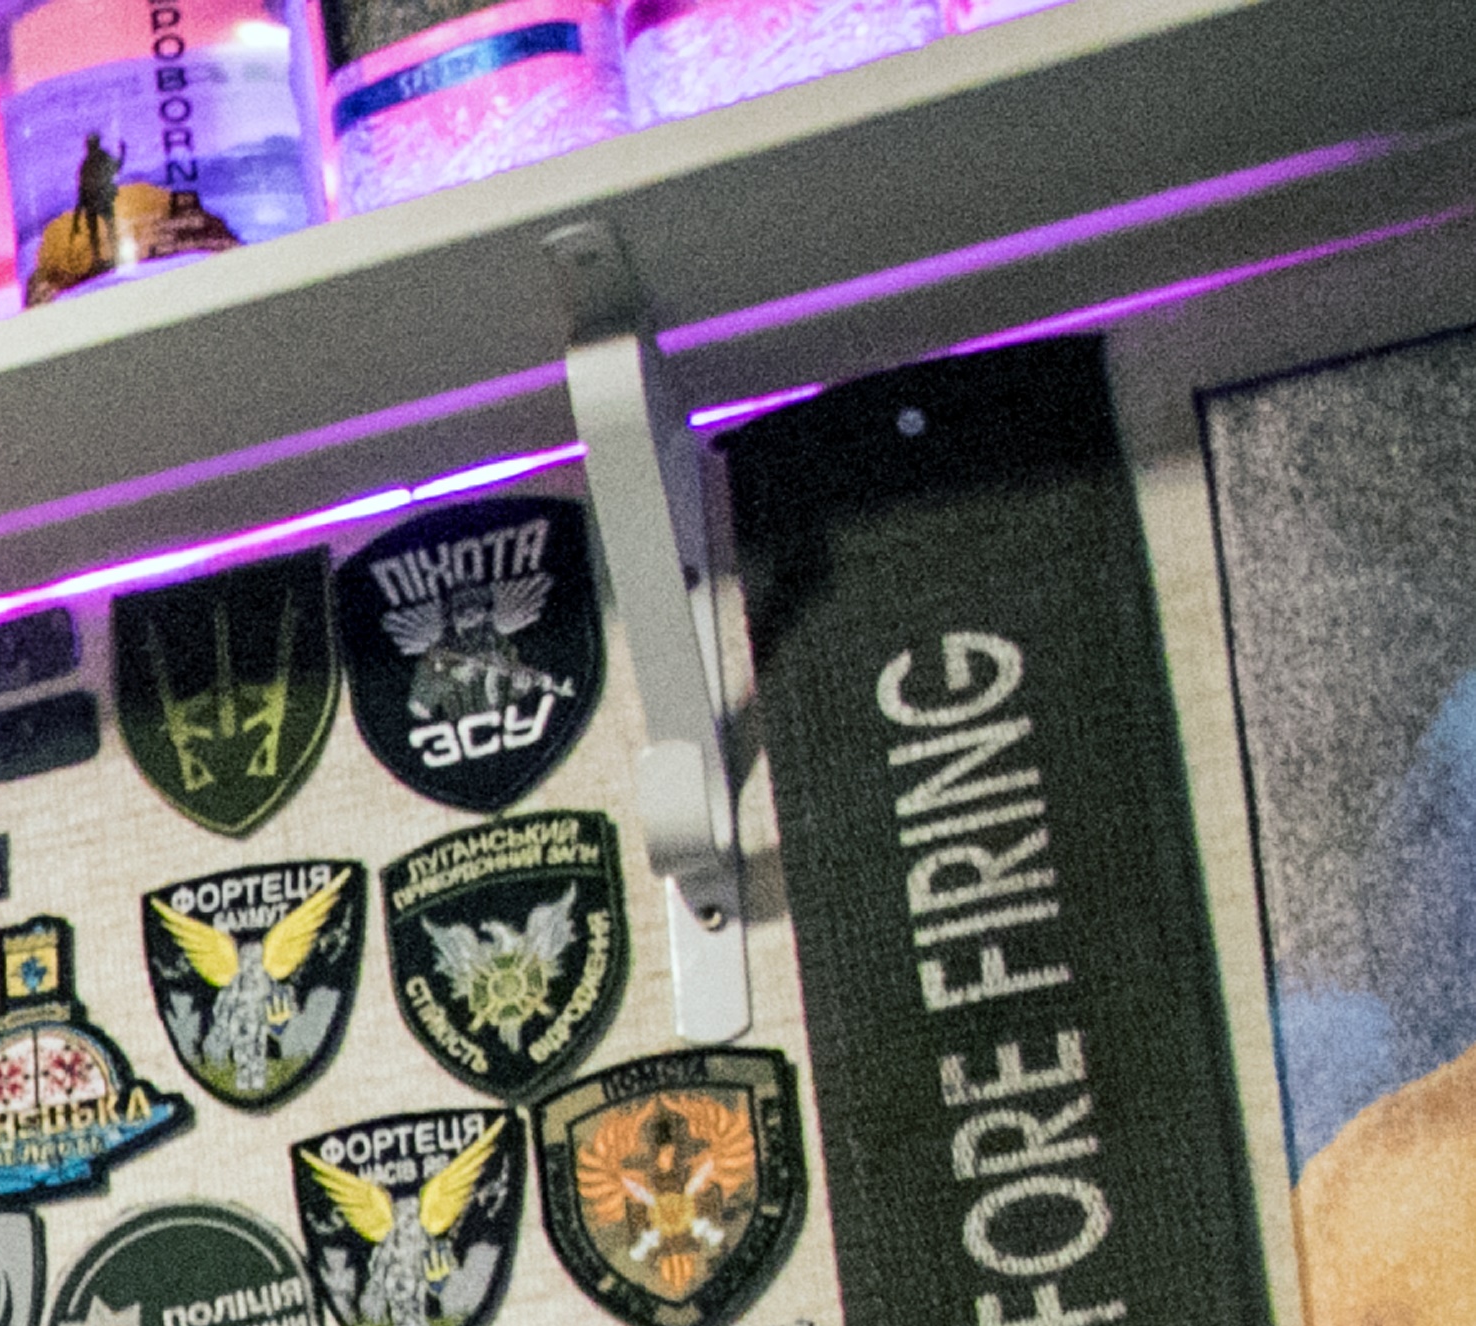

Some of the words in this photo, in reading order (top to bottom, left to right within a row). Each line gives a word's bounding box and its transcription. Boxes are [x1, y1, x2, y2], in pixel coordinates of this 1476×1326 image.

[372, 520, 550, 606] ПІХОТА
[408, 690, 556, 769] ЗСУ
[408, 819, 580, 884] ЛУГАНСЬКИЙ
[876, 626, 1075, 1013] FIRING
[172, 864, 332, 916] ФОРТЕЦЯ
[319, 1111, 487, 1167] ФОРТЕЦЯ
